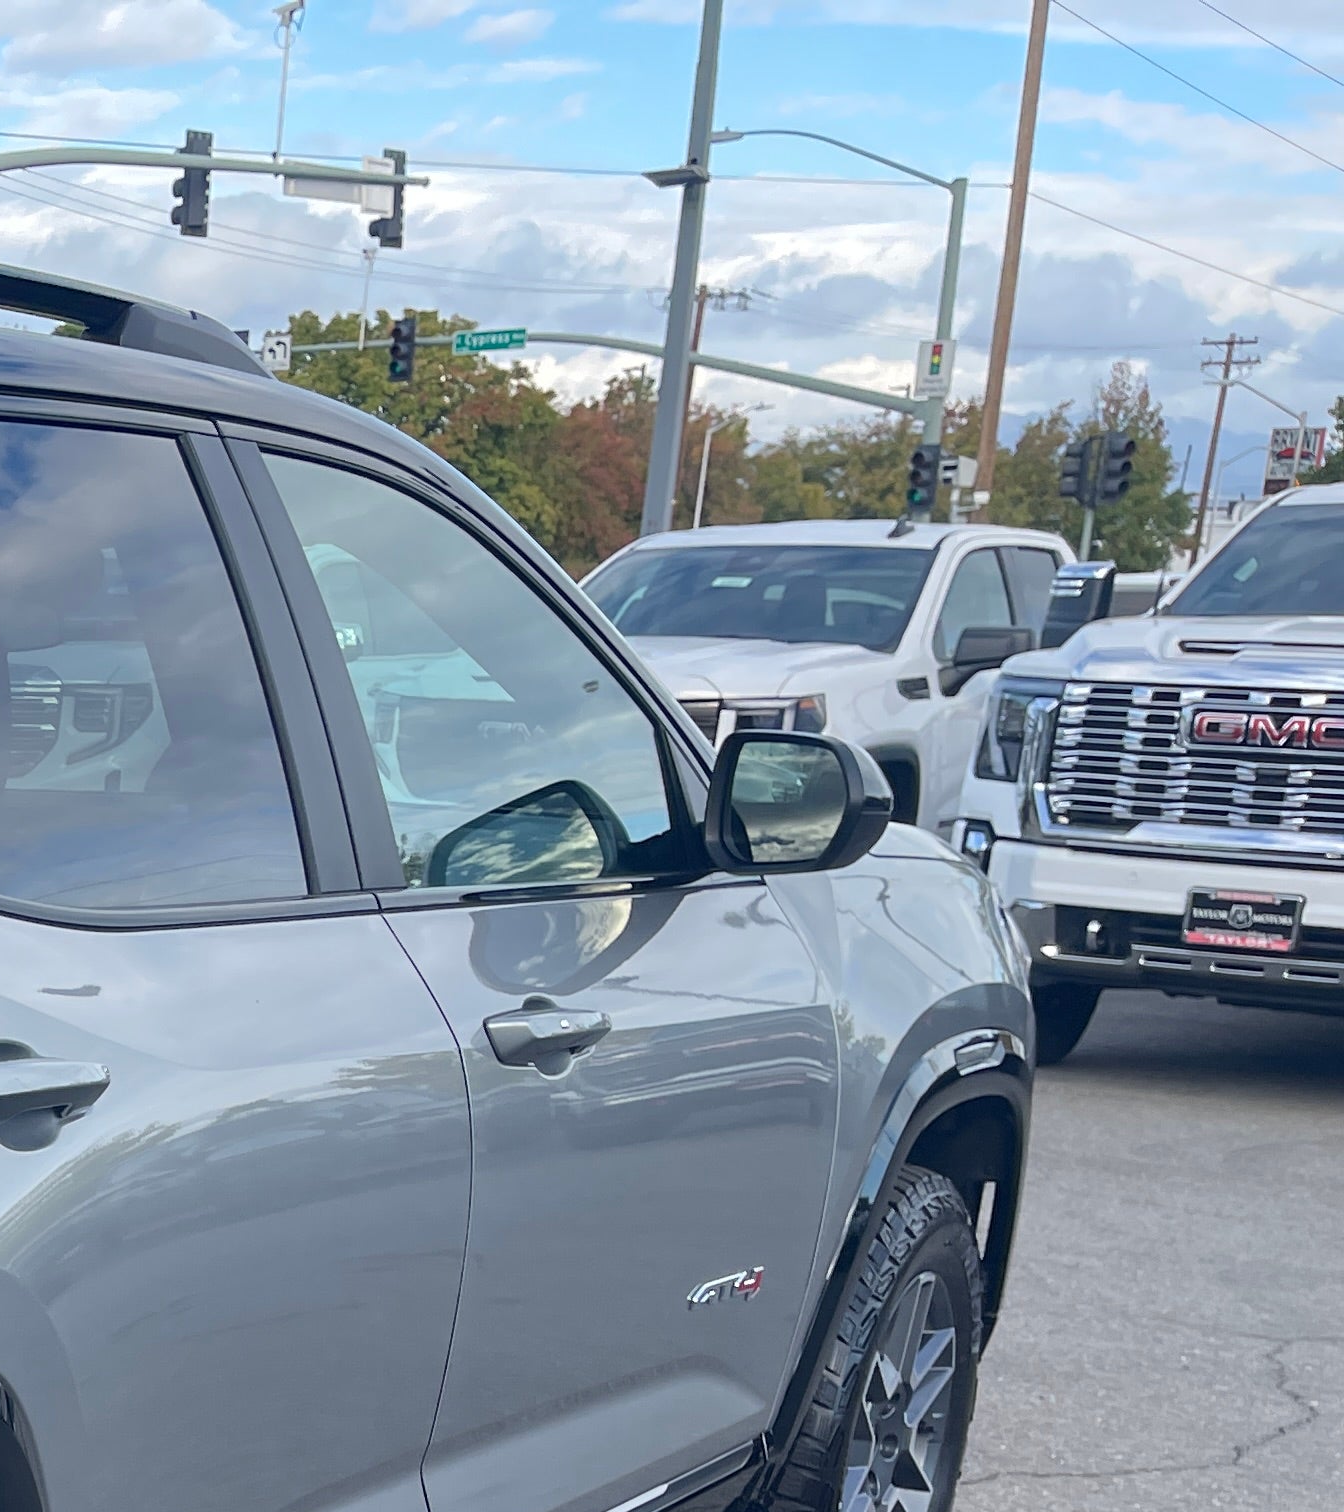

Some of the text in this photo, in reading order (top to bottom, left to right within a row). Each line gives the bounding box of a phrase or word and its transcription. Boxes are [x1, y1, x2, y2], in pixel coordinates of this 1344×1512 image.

[465, 333, 511, 348] Cypress
[1194, 711, 1344, 748] GMC
[687, 1265, 765, 1305] AT4
